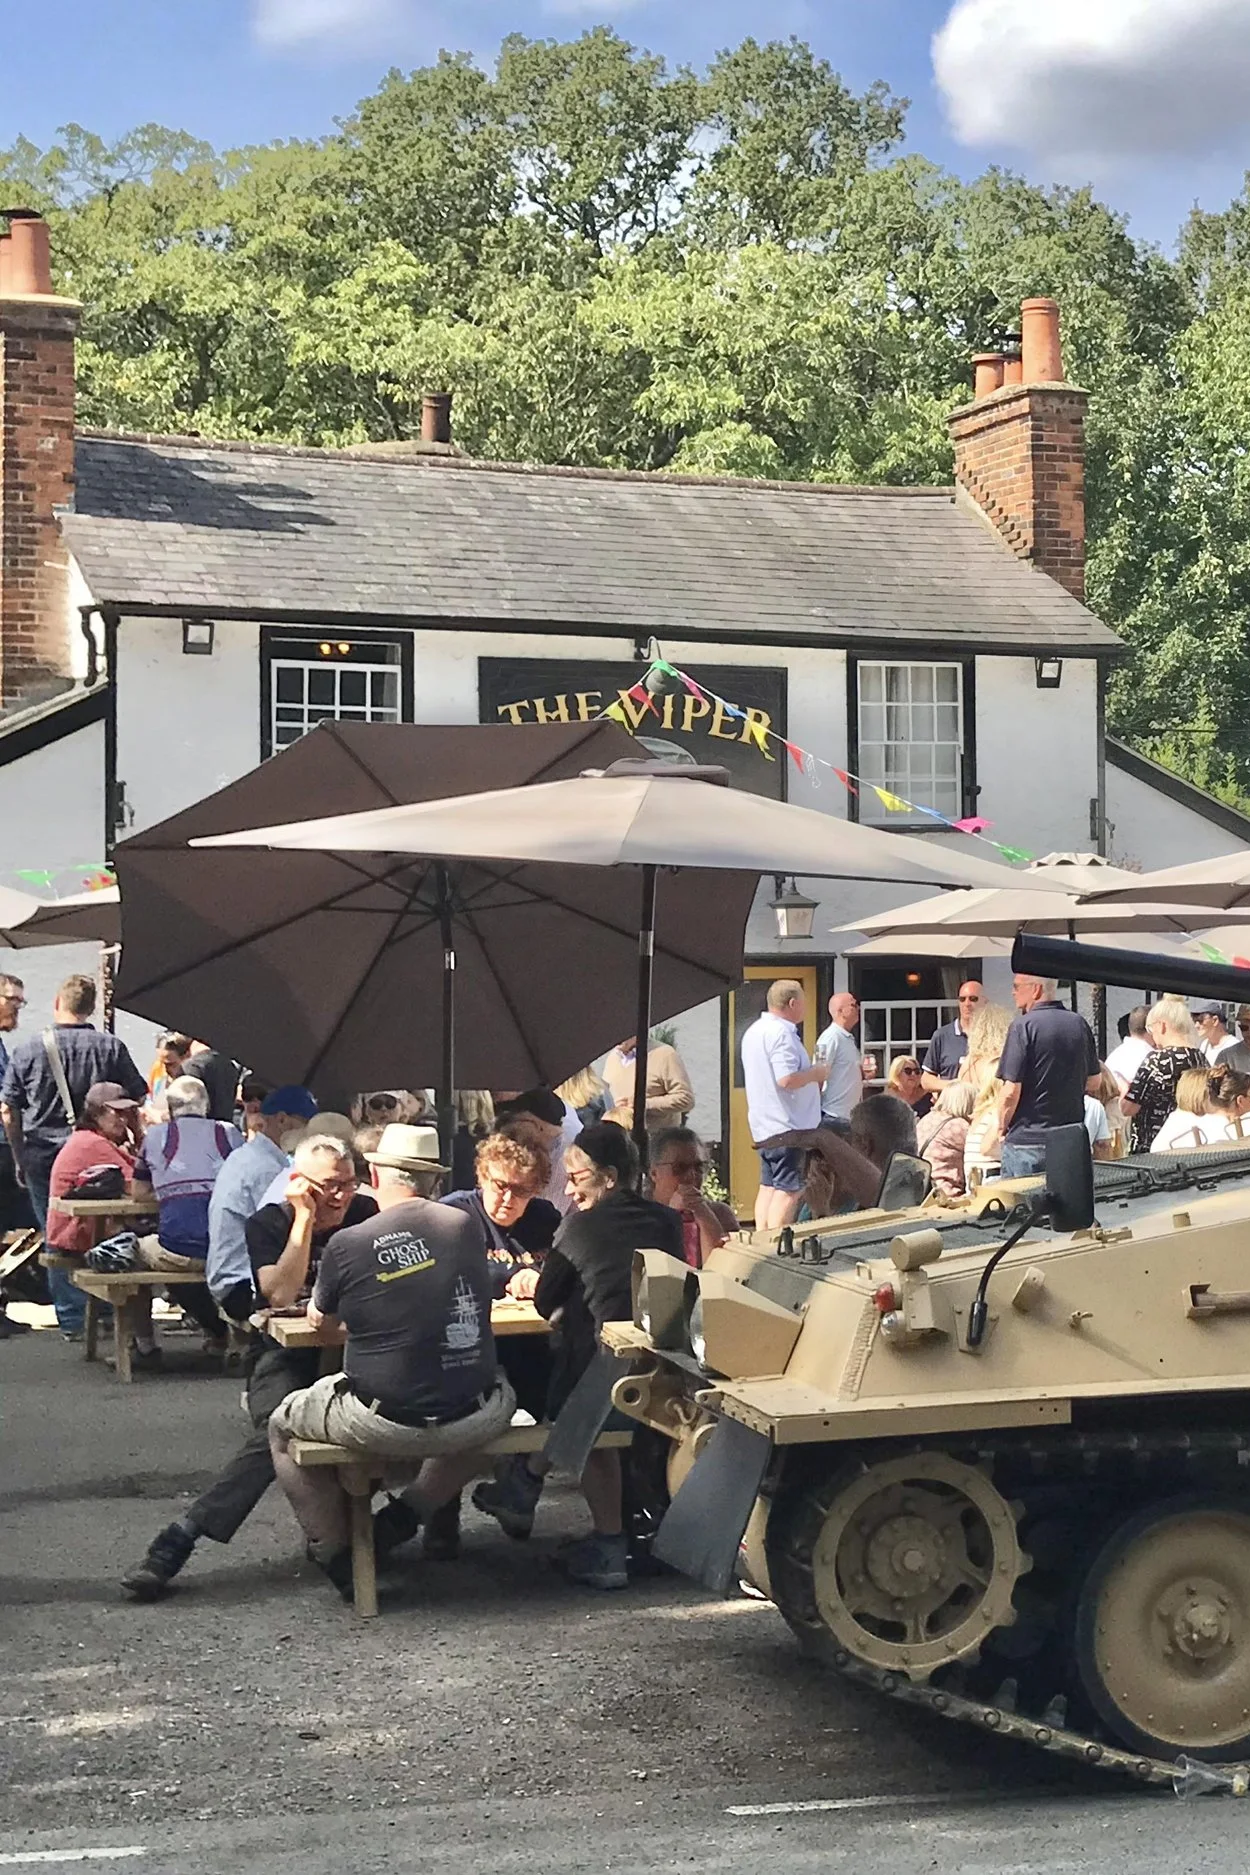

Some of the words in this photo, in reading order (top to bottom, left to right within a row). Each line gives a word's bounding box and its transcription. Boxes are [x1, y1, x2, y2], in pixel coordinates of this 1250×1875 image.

[497, 691, 602, 725] THE
[617, 690, 772, 745] VIPER
[377, 1238, 425, 1265] GHOST
[398, 1248, 430, 1269] SHIP
